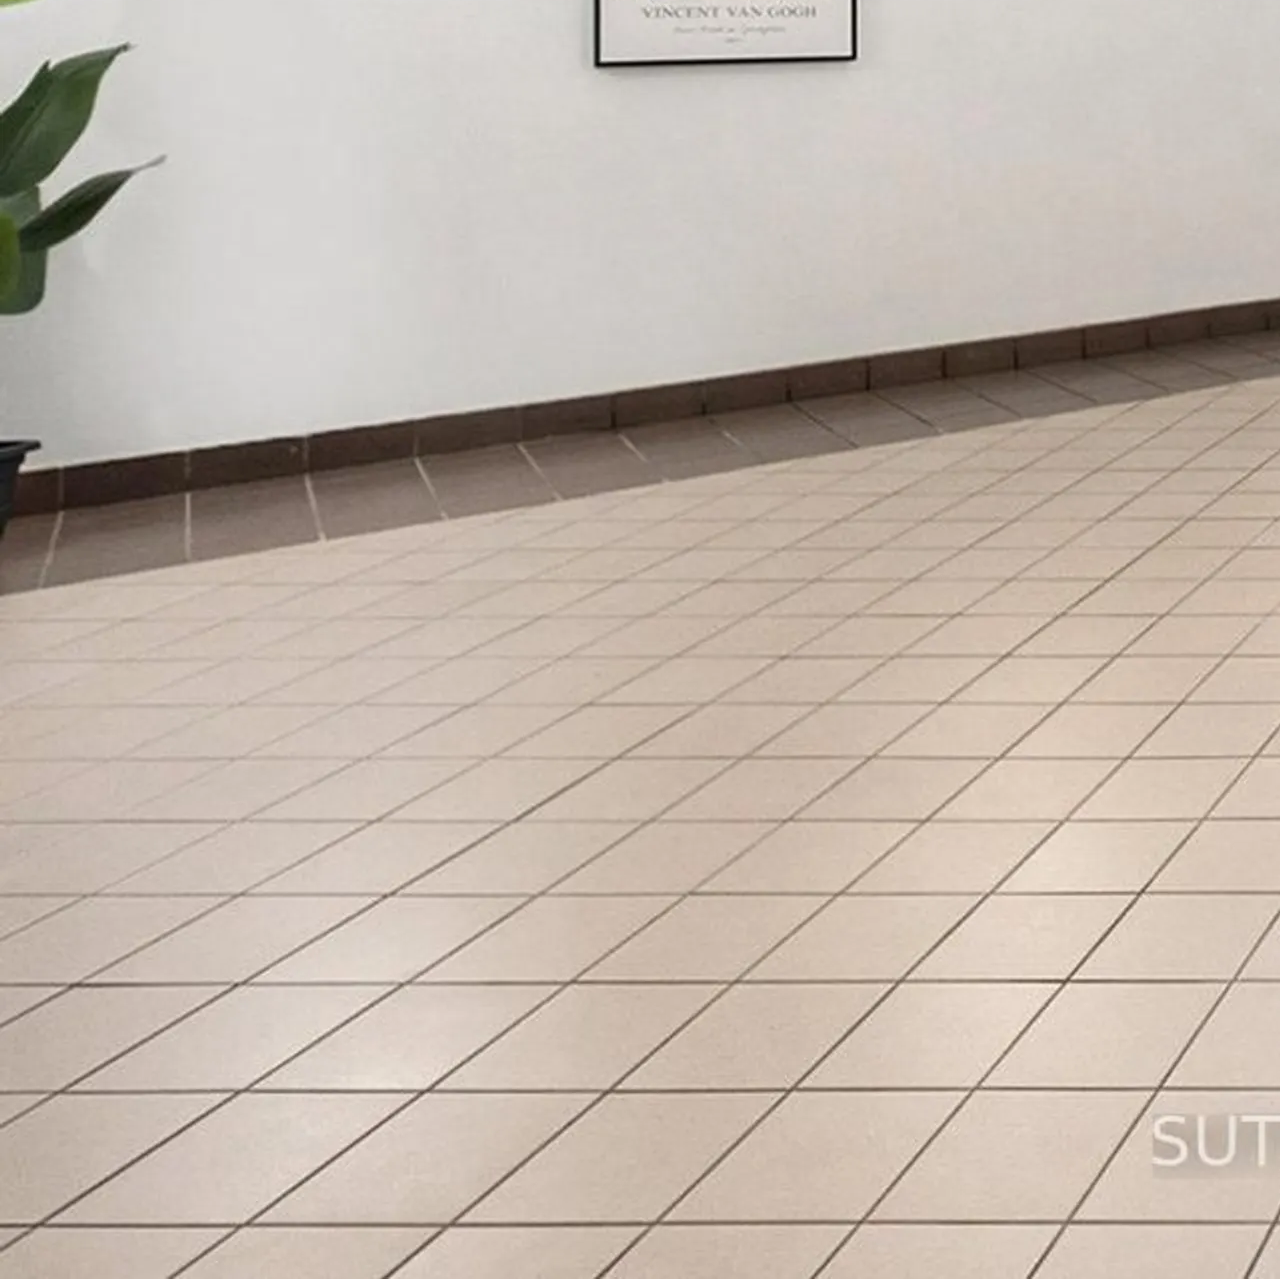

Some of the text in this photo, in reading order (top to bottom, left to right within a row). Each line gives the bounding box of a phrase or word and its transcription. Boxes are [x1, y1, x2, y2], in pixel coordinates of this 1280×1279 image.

[643, 5, 816, 19] VINCENT VAN GOGH
